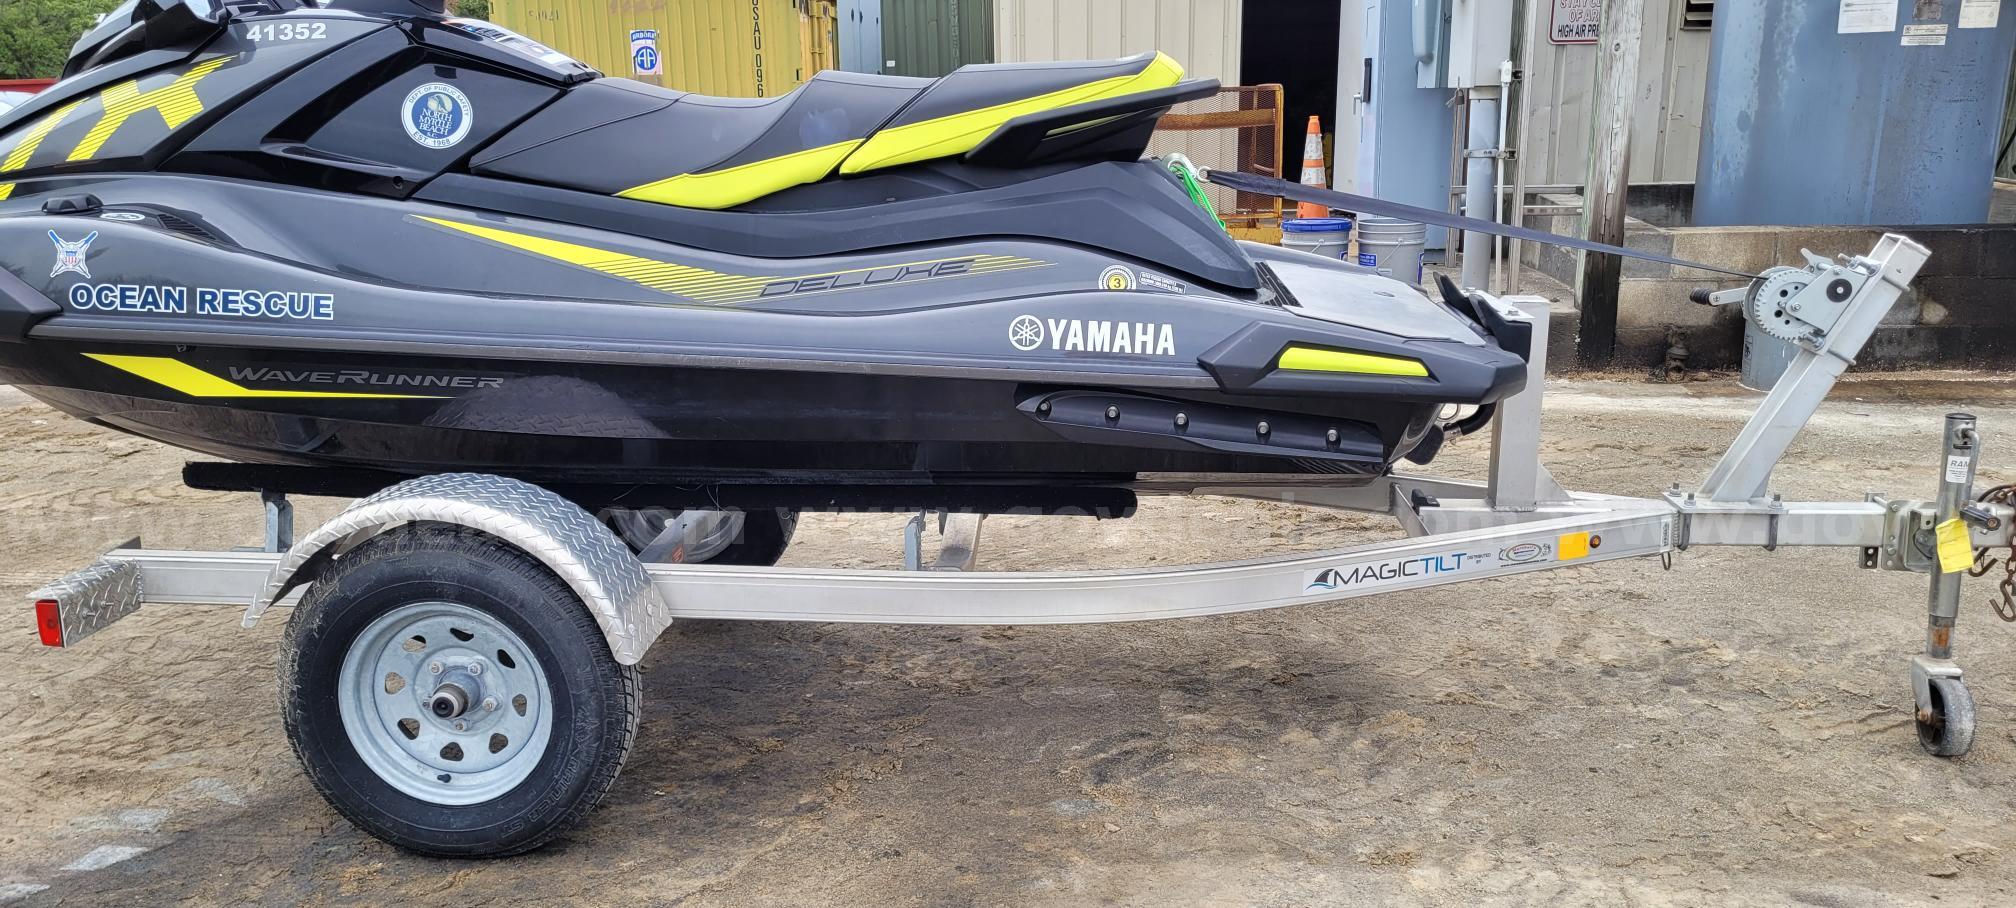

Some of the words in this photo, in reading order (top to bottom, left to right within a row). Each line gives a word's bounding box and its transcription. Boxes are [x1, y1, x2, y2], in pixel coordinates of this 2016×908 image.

[1569, 9, 1583, 23] OF
[246, 22, 327, 42] 41352
[1557, 24, 1573, 38] HIGH
[1575, 24, 1586, 38] AIR
[434, 86, 457, 96] PUBLIC
[422, 107, 453, 122] NORTH
[419, 115, 453, 129] MYRTLE
[420, 122, 449, 136] BEACH
[758, 258, 976, 298] DELUXE
[1113, 277, 1121, 288] 3
[69, 282, 187, 314] OCEAN
[196, 288, 334, 321] RESCUE
[1048, 318, 1176, 356] YAMAHA
